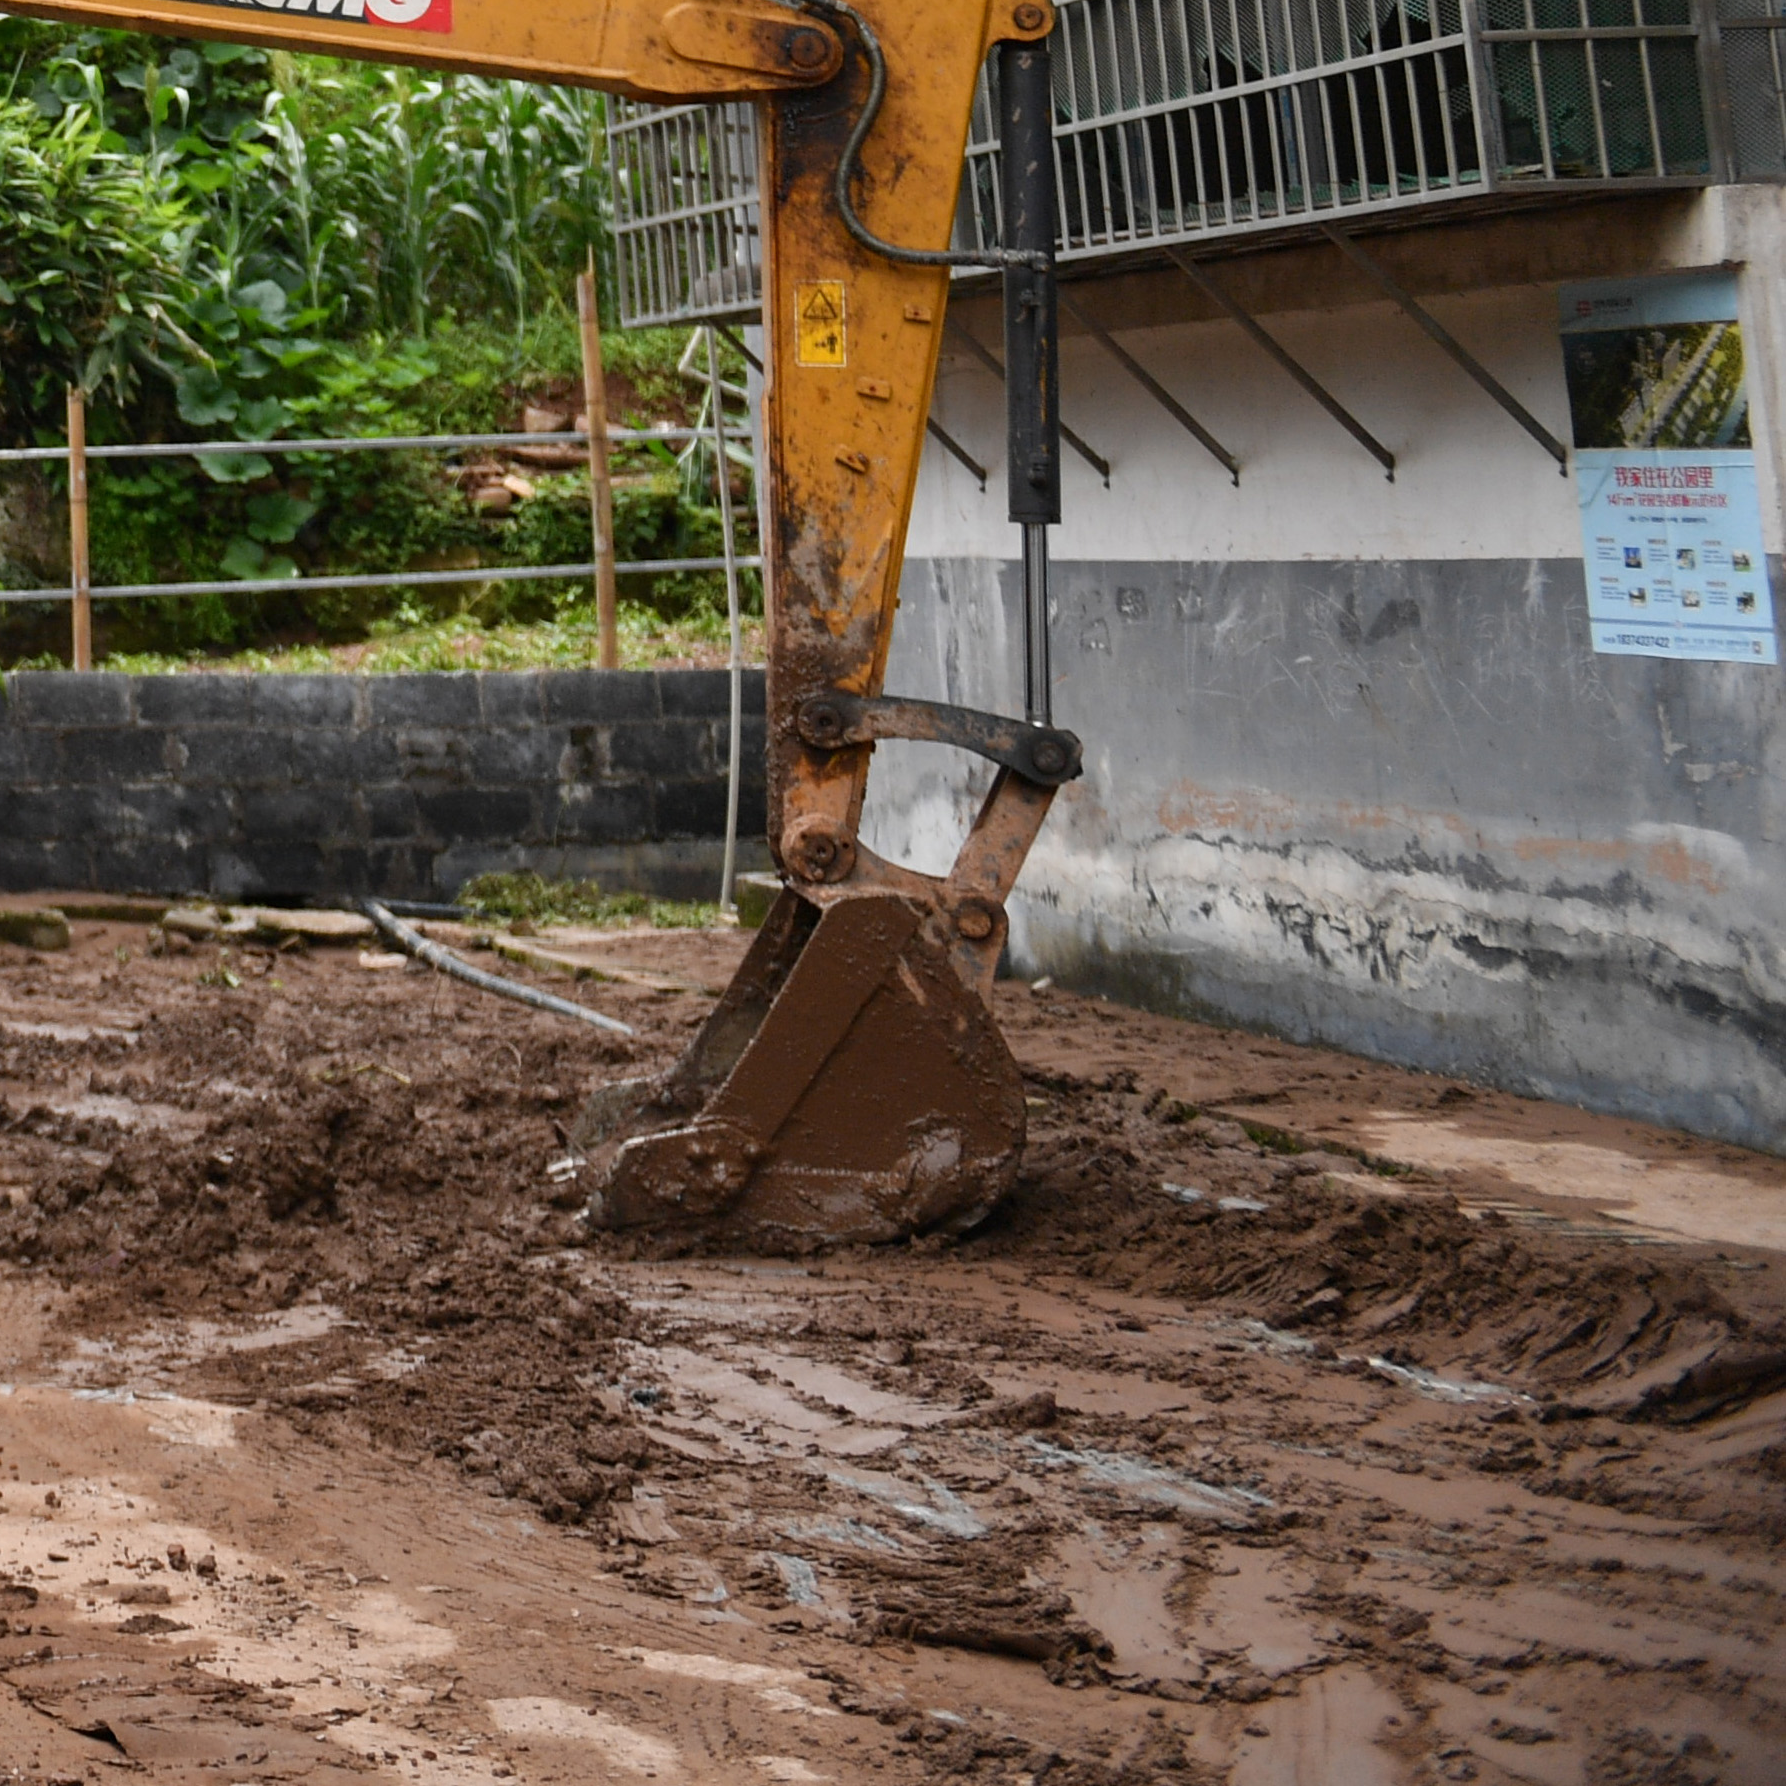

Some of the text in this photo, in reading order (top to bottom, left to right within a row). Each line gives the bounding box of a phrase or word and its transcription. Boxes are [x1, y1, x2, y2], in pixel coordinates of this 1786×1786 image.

[1613, 465, 1715, 489] 我家住在公园里
